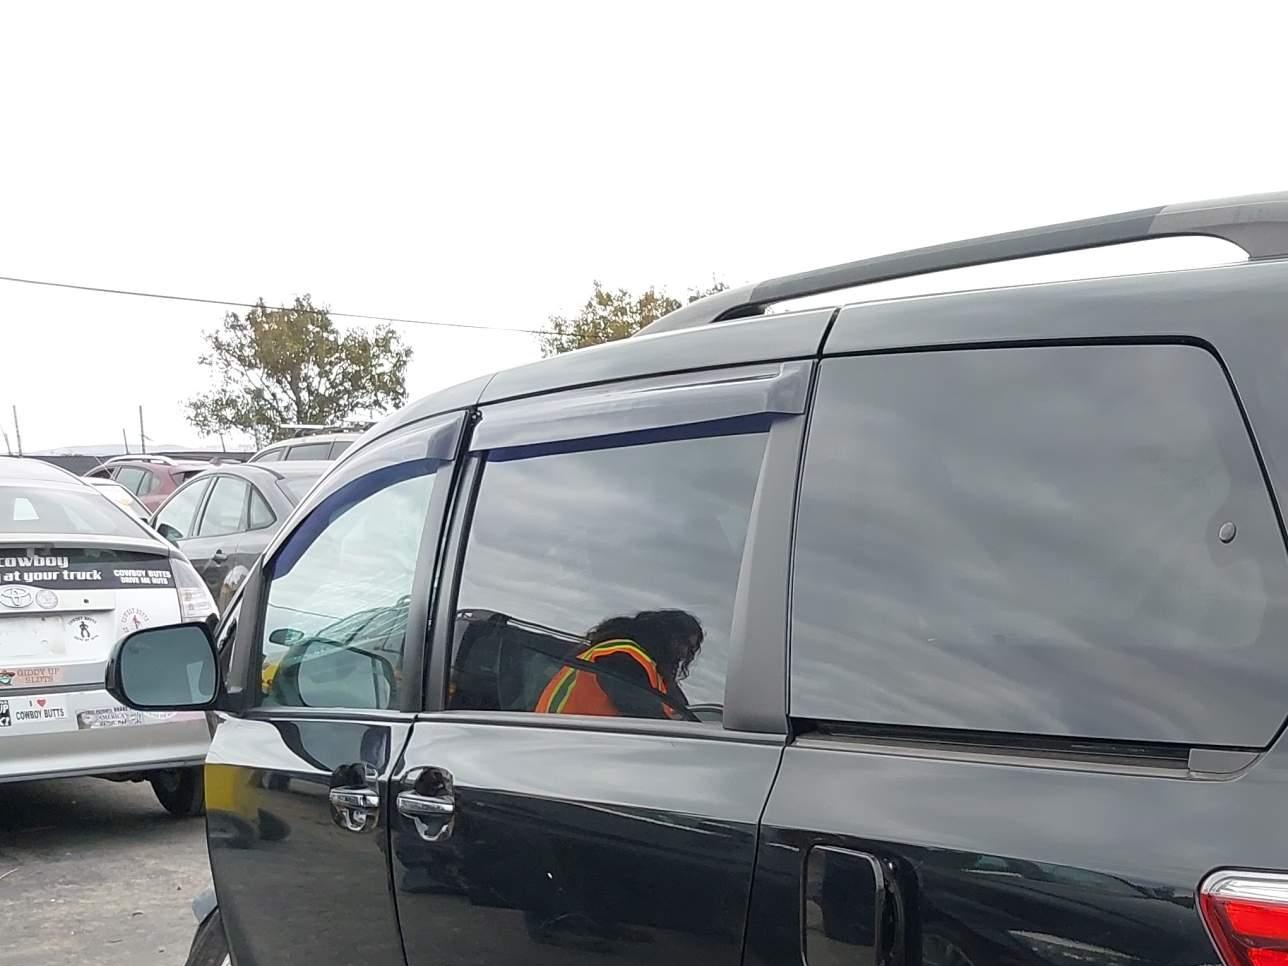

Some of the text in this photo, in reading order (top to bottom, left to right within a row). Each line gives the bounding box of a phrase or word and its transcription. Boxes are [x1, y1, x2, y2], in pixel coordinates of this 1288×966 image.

[3, 570, 101, 582] at your truck
[16, 708, 65, 720] COWBOY BUTTS
